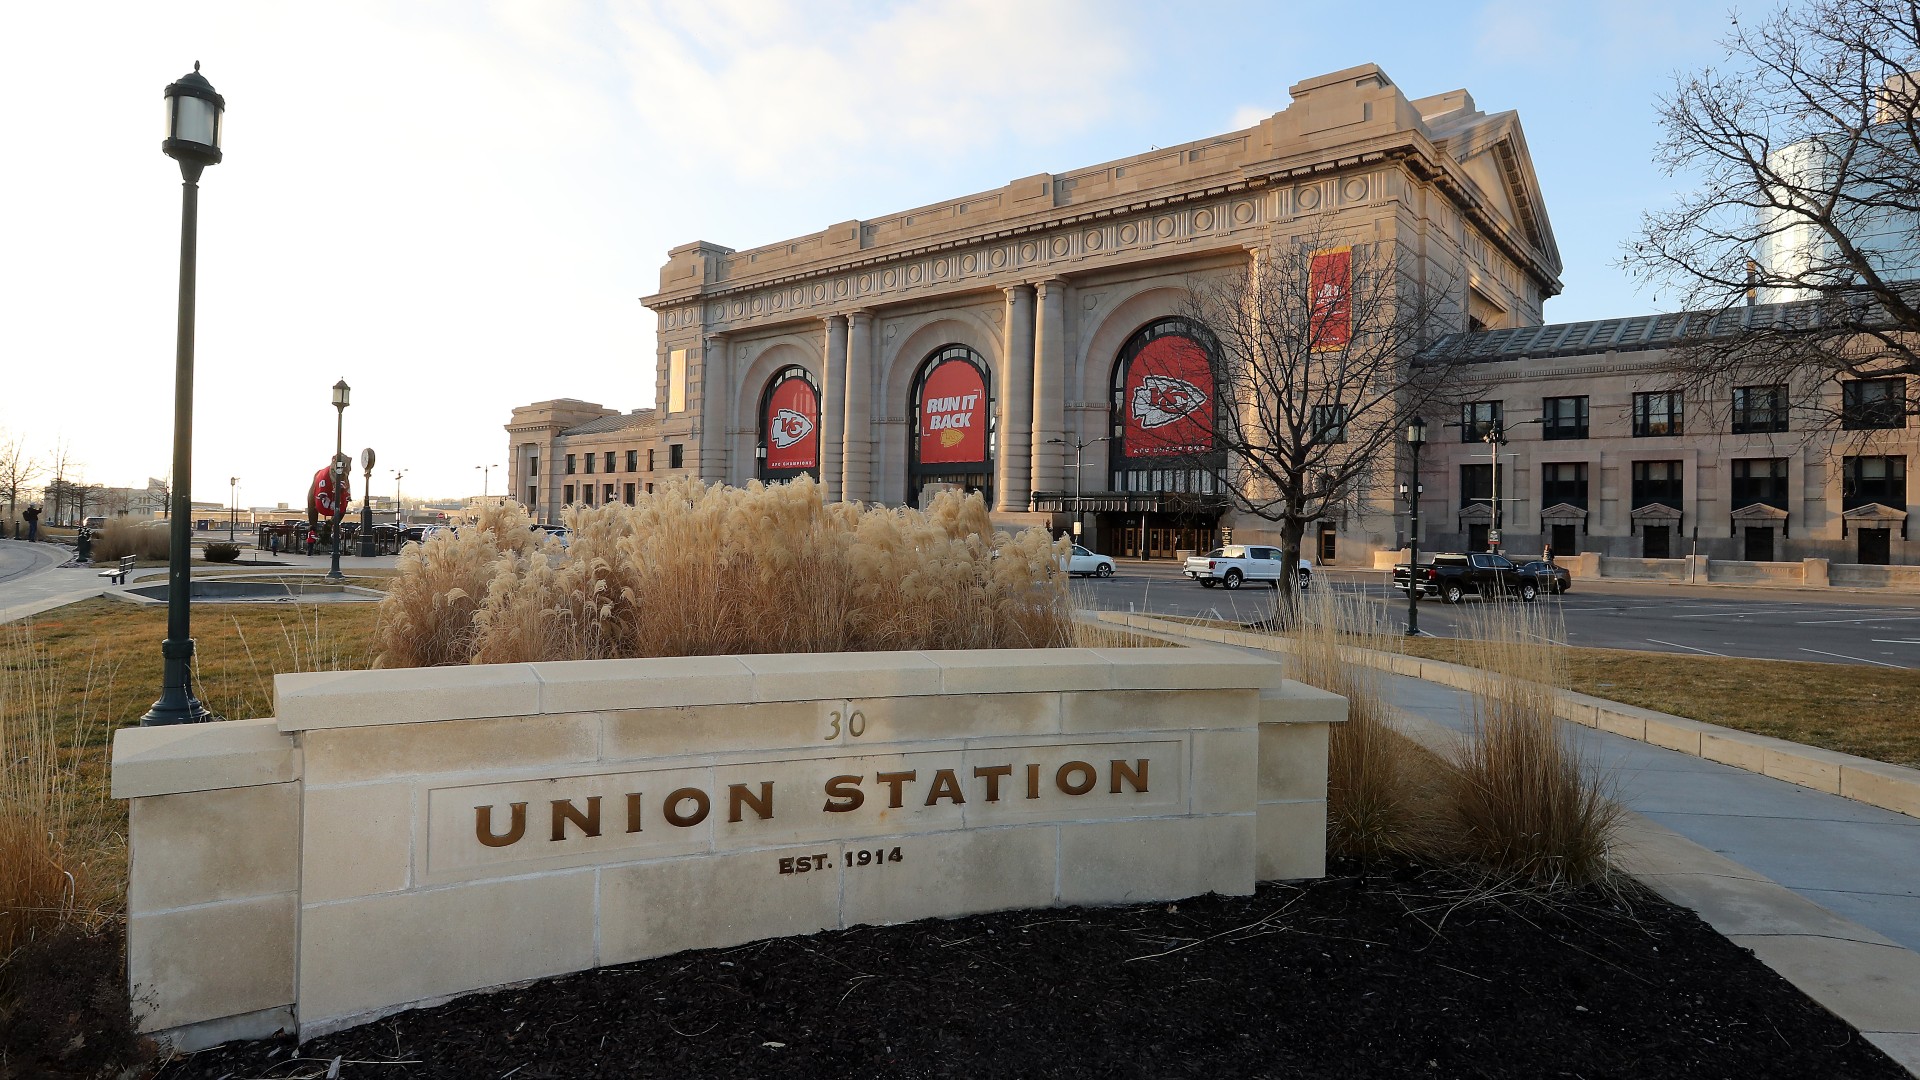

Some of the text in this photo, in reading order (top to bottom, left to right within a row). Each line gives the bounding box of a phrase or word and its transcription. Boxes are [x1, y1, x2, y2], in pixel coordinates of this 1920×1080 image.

[927, 394, 978, 414] RUN IT
[780, 416, 803, 438] KC
[930, 412, 972, 430] BACK
[823, 709, 866, 740] 30
[474, 758, 1150, 848] UNION STATION
[778, 846, 904, 875] EST. 1914
